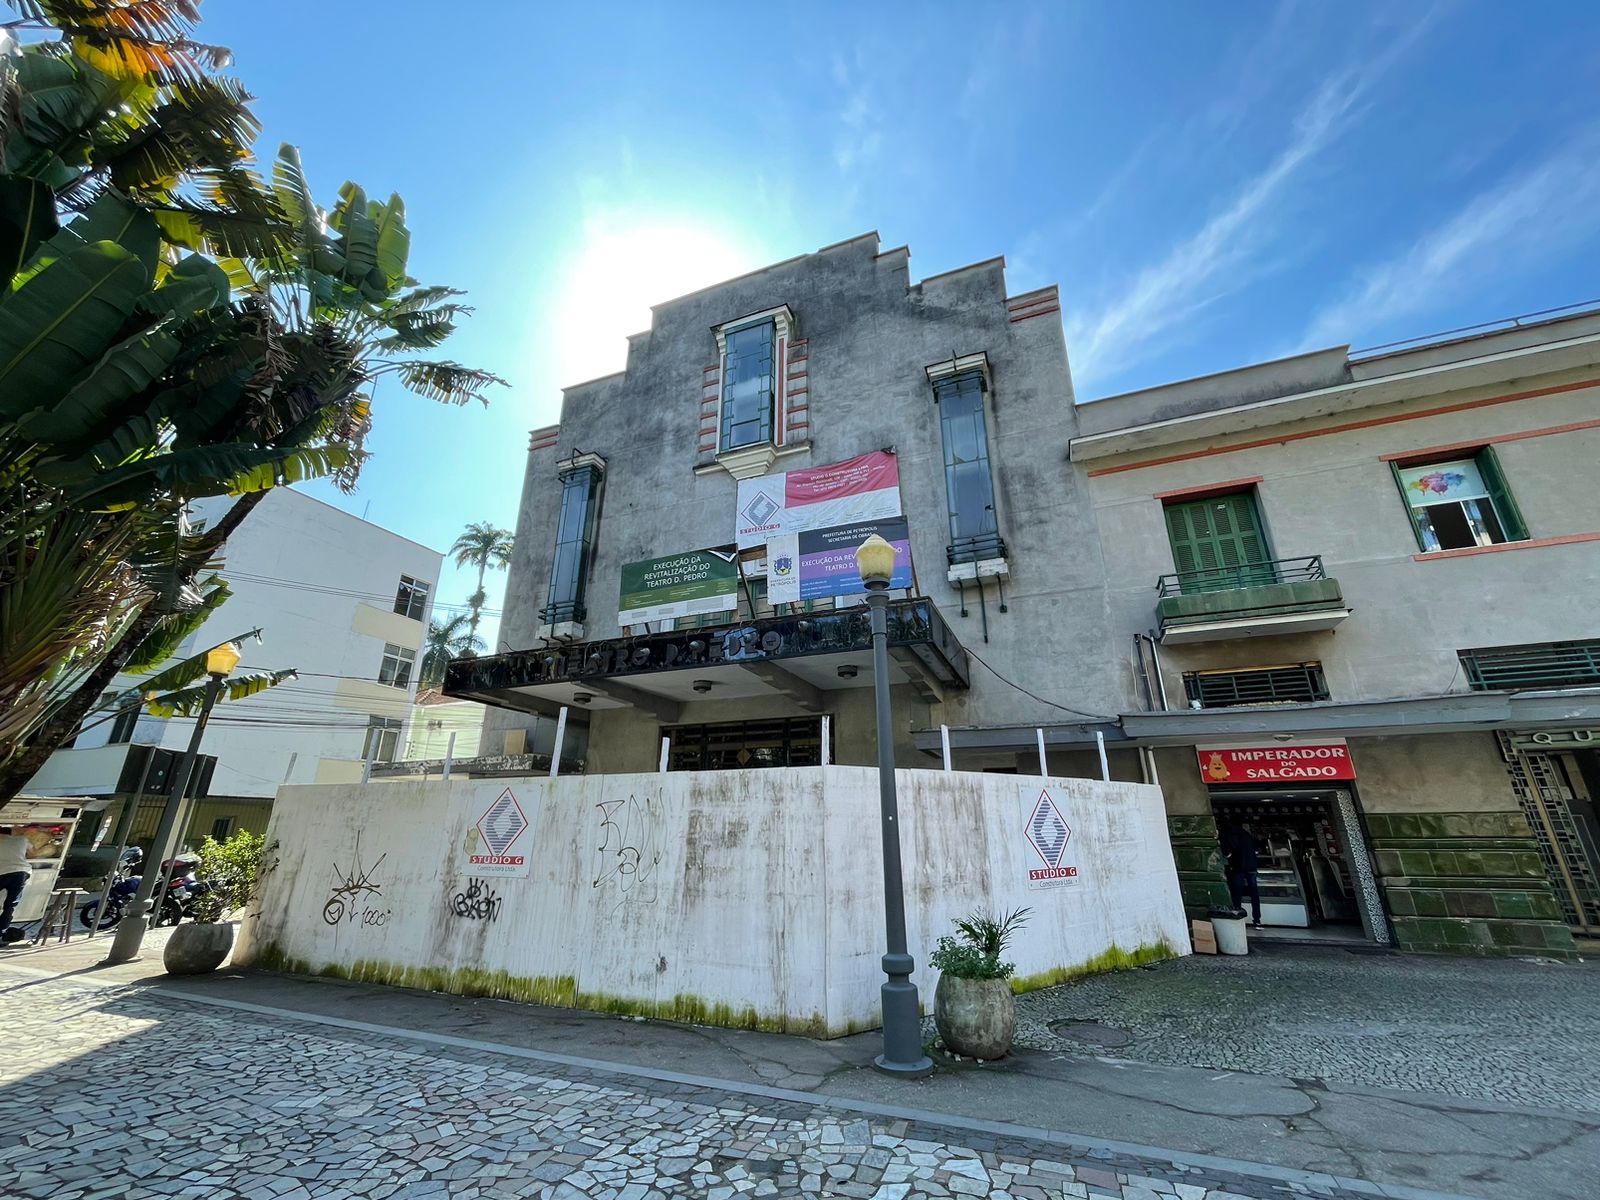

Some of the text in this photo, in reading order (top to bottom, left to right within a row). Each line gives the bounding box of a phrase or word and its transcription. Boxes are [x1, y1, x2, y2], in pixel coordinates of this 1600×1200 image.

[822, 530, 848, 538] PREFEITURA
[853, 526, 878, 534] PETRÓPOLIS
[828, 535, 851, 543] SECRETARIA
[653, 557, 689, 571] EXECUÇÃO
[801, 556, 832, 567] EXECUÇÃO
[644, 562, 710, 580] REVITALIZAÇÃO DO
[646, 577, 672, 588] TEATRO
[684, 571, 707, 582] PEDRO
[1231, 747, 1345, 761] IMPERADOR
[1247, 766, 1338, 779] SALGADO
[472, 856, 511, 864] STUDIO
[1031, 867, 1076, 879] STUDIO G
